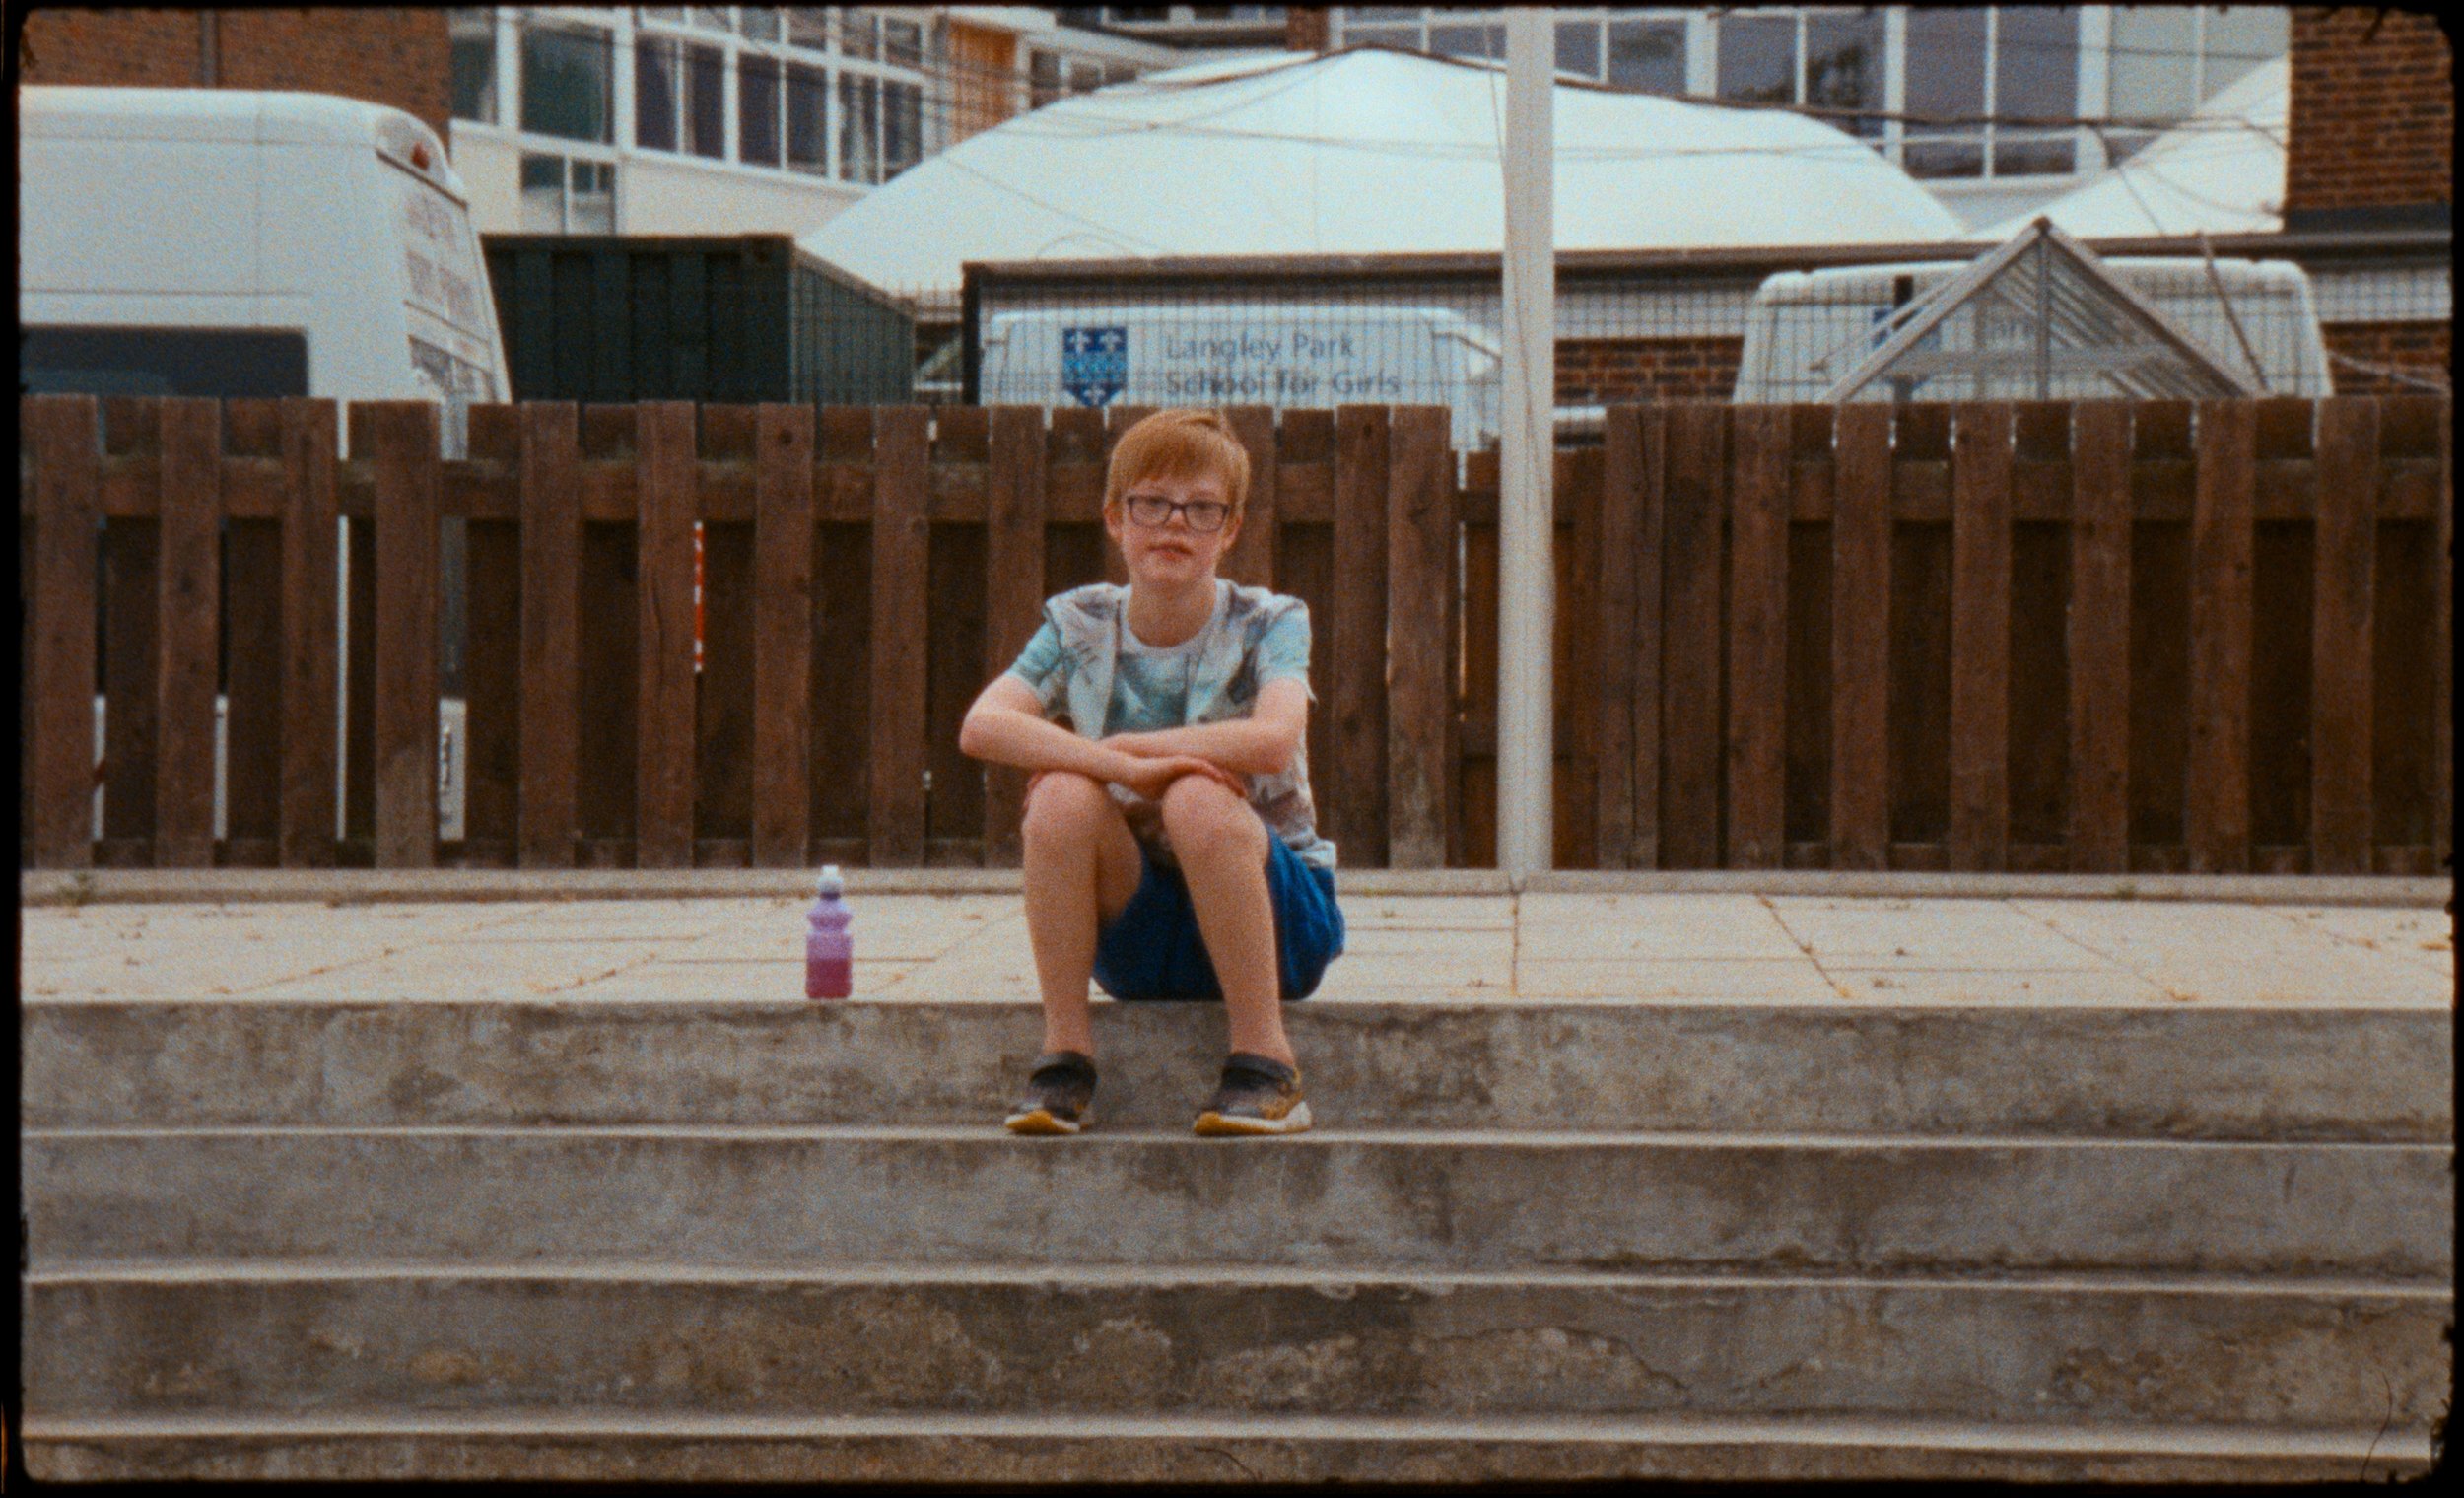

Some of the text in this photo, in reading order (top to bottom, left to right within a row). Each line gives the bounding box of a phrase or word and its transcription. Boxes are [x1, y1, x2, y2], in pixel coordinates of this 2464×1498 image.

[1167, 332, 1354, 364] Langley Park
[1166, 369, 1266, 396] School
[1332, 369, 1401, 396] Girls
